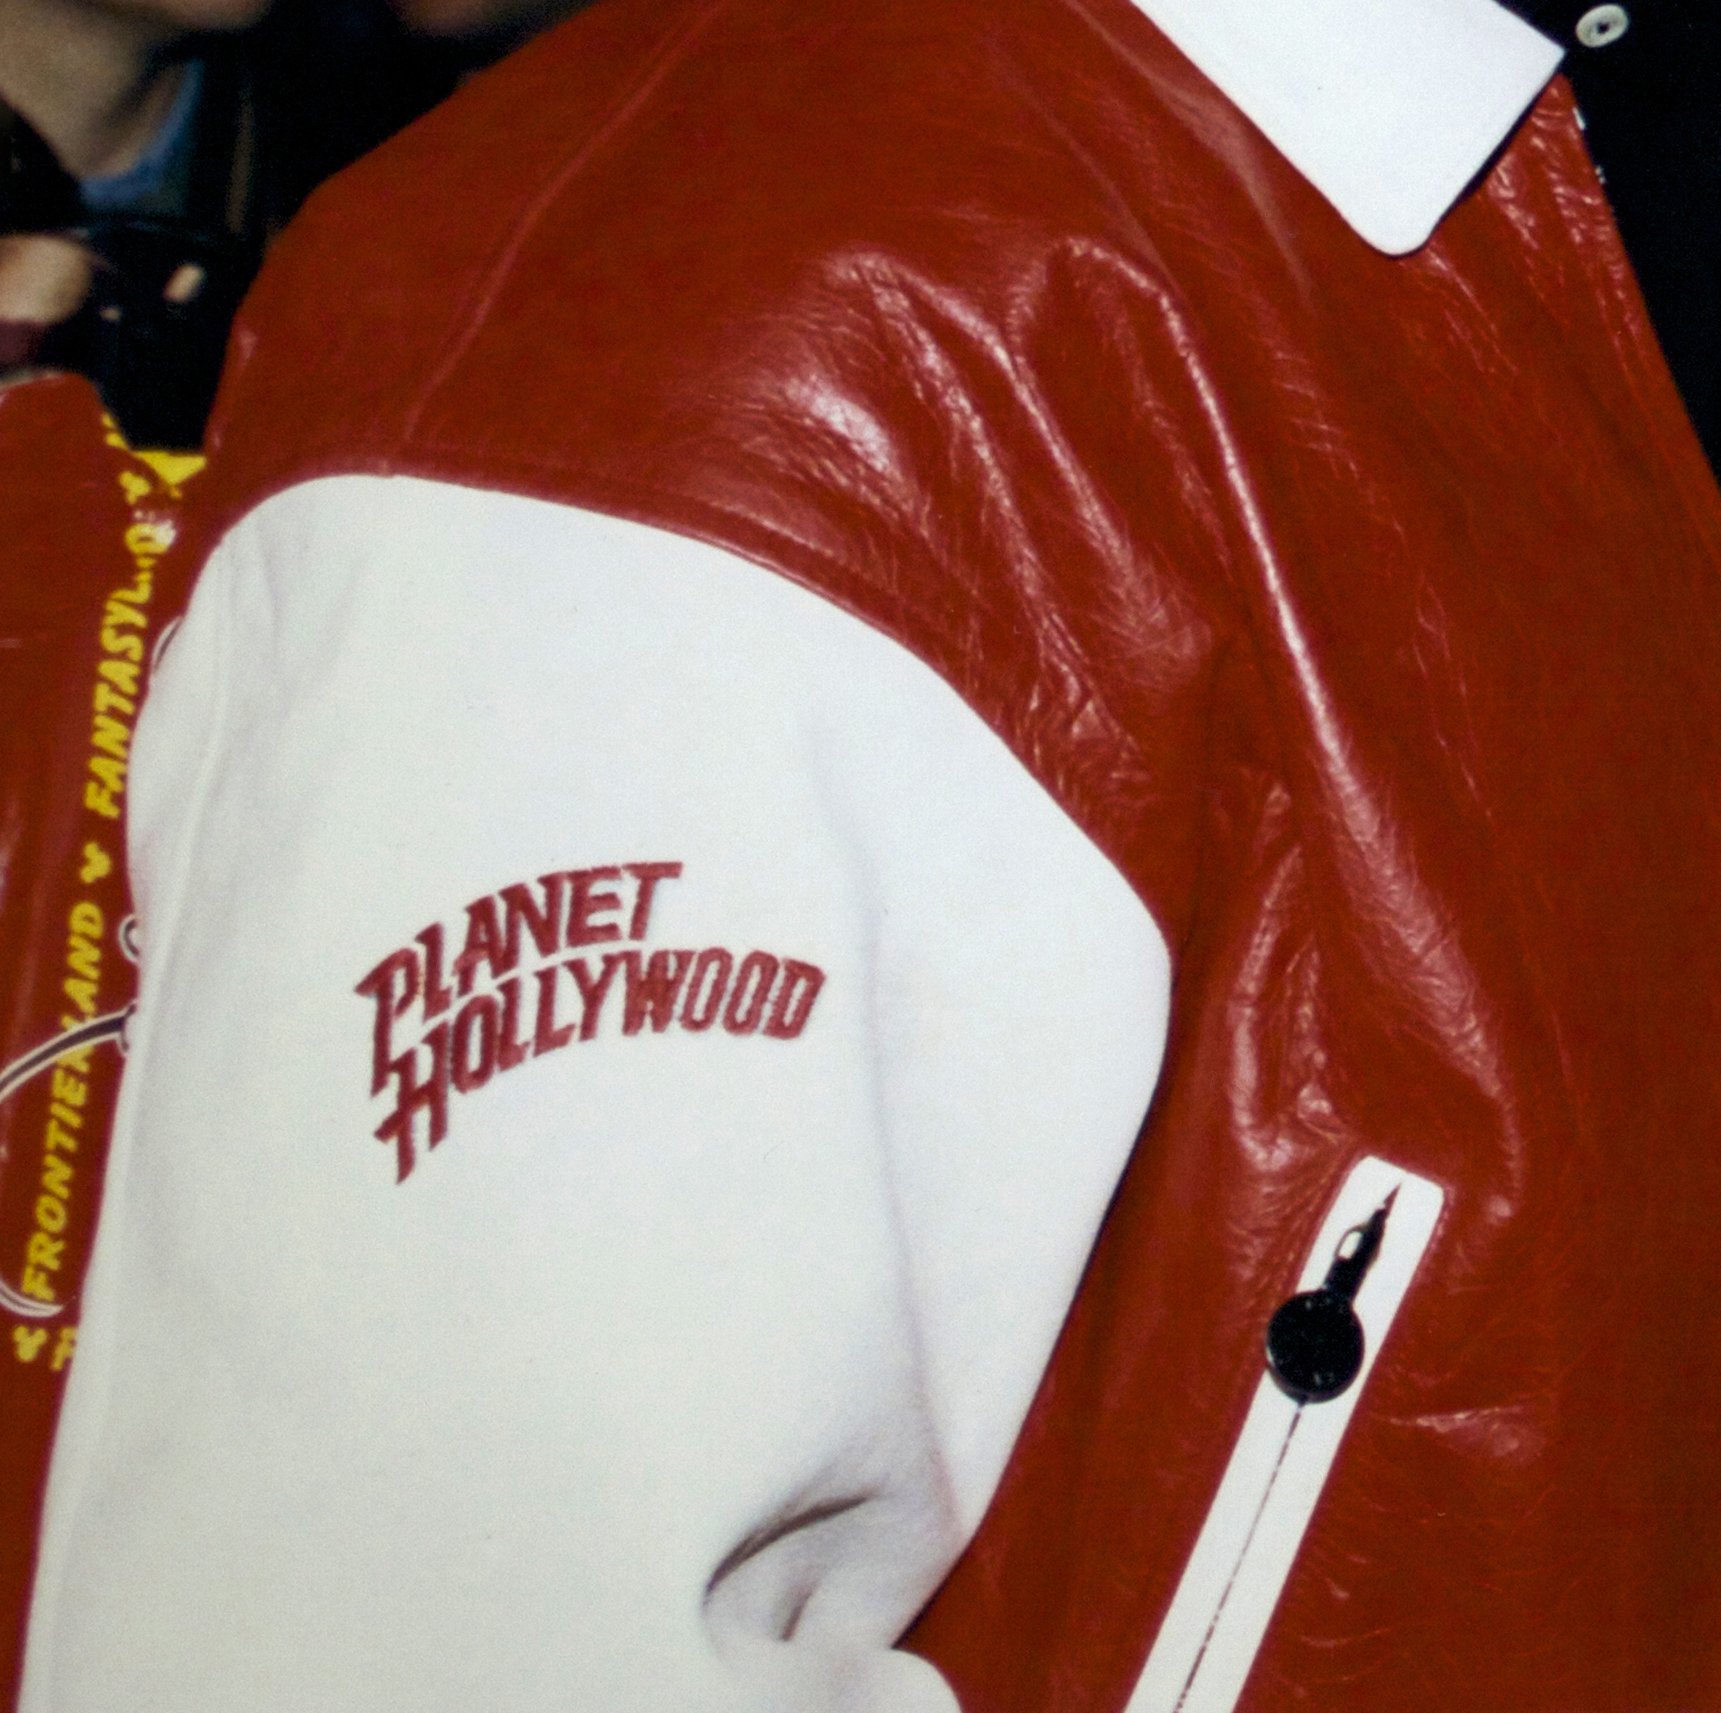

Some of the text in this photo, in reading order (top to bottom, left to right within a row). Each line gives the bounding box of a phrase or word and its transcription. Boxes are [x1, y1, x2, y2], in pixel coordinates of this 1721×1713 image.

[83, 519, 176, 820] FANTASYLD
[352, 860, 684, 1099] PLANET
[372, 945, 827, 1186] HOLLYWOOD
